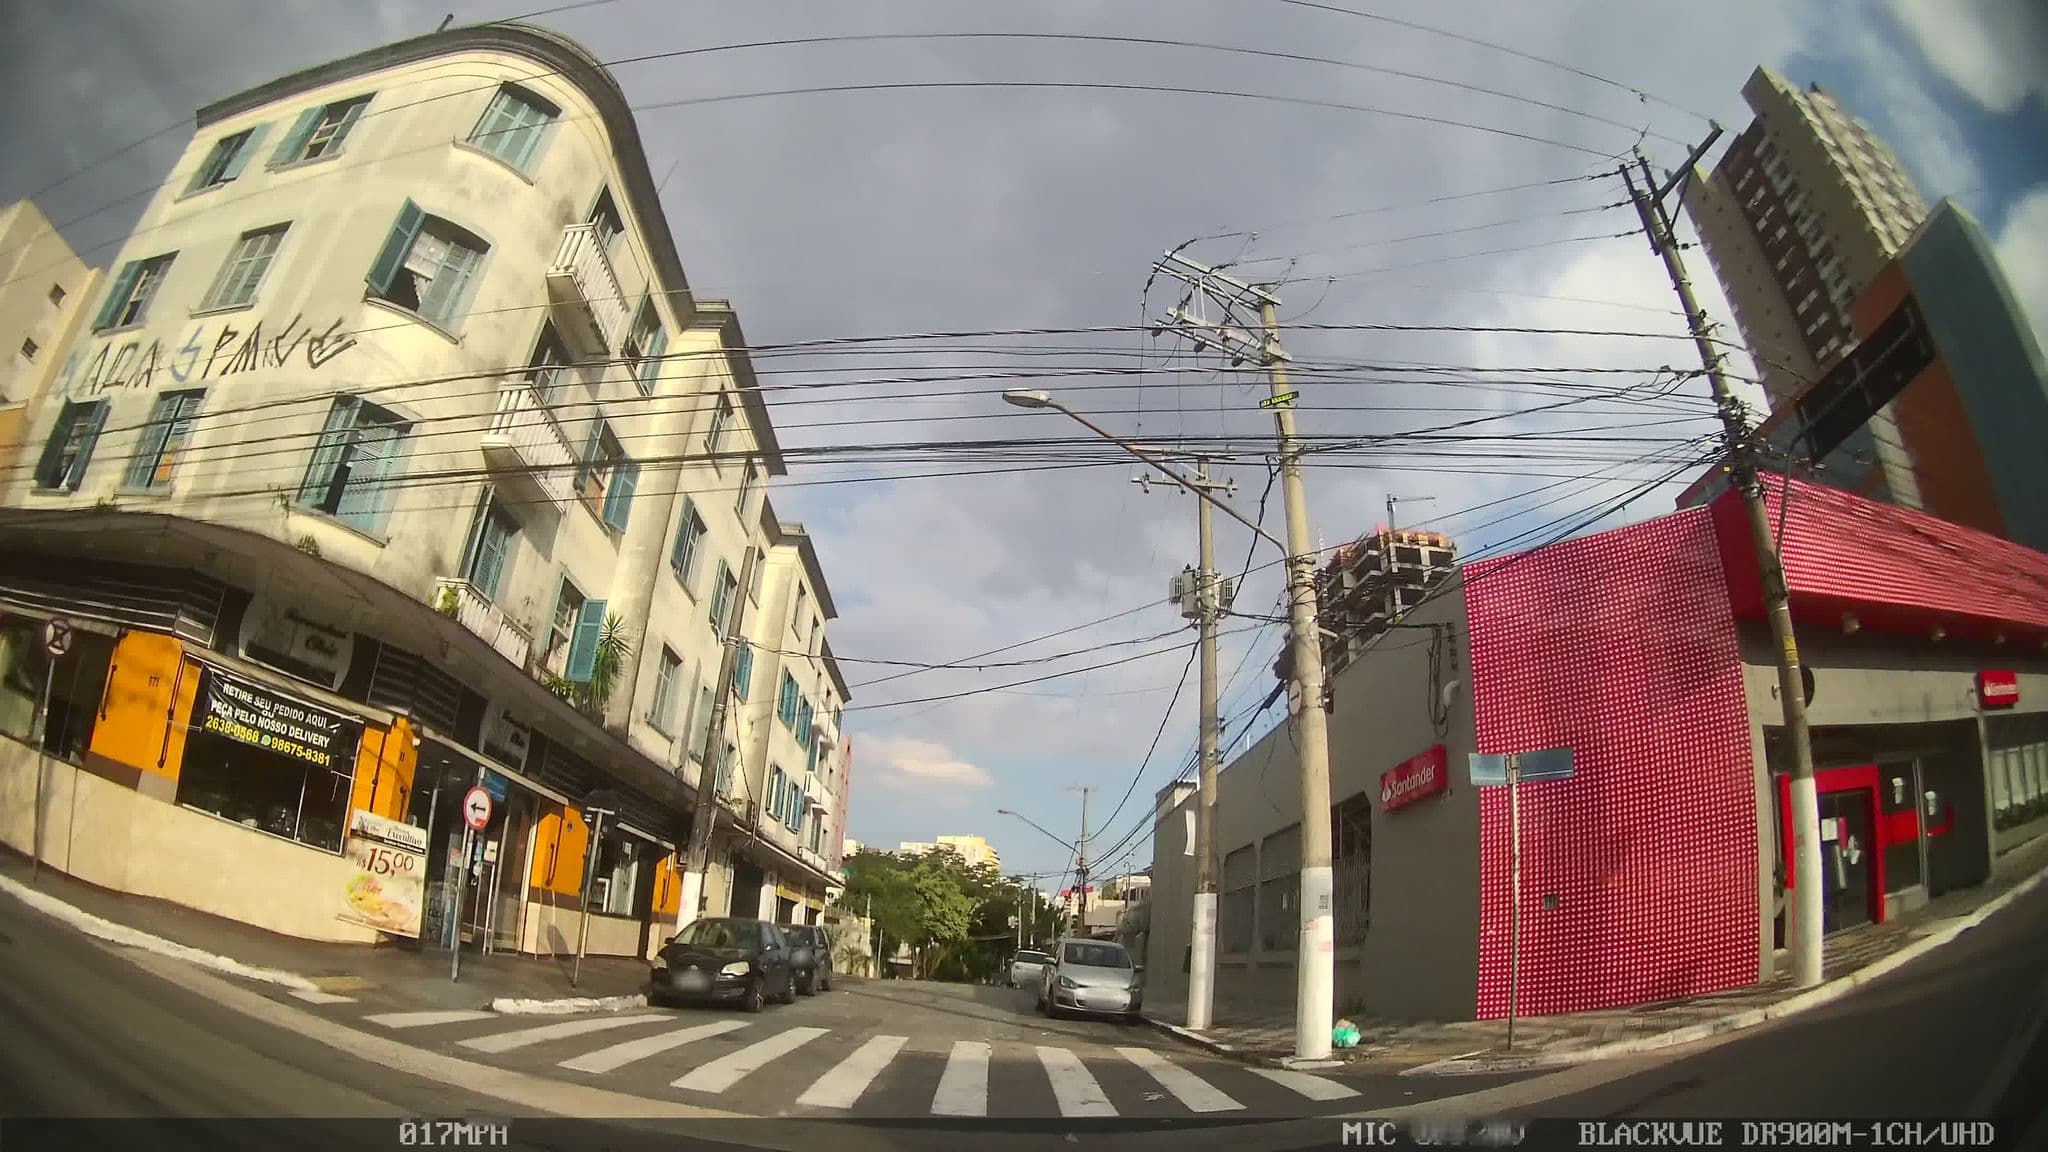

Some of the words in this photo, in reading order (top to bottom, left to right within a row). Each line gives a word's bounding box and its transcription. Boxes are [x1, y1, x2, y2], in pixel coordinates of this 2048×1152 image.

[210, 700, 233, 718] PEÇA
[234, 708, 257, 725] PELO
[257, 717, 288, 735] NOSSO
[288, 727, 331, 749] DELIVERY
[222, 683, 253, 704] RETIRE
[254, 696, 272, 711] SEU
[273, 703, 305, 721] PEDIDO
[305, 715, 328, 729] AQUI
[205, 715, 260, 743] 2638-0568
[271, 737, 332, 767] 98675-8381
[1390, 763, 1436, 799] Santander
